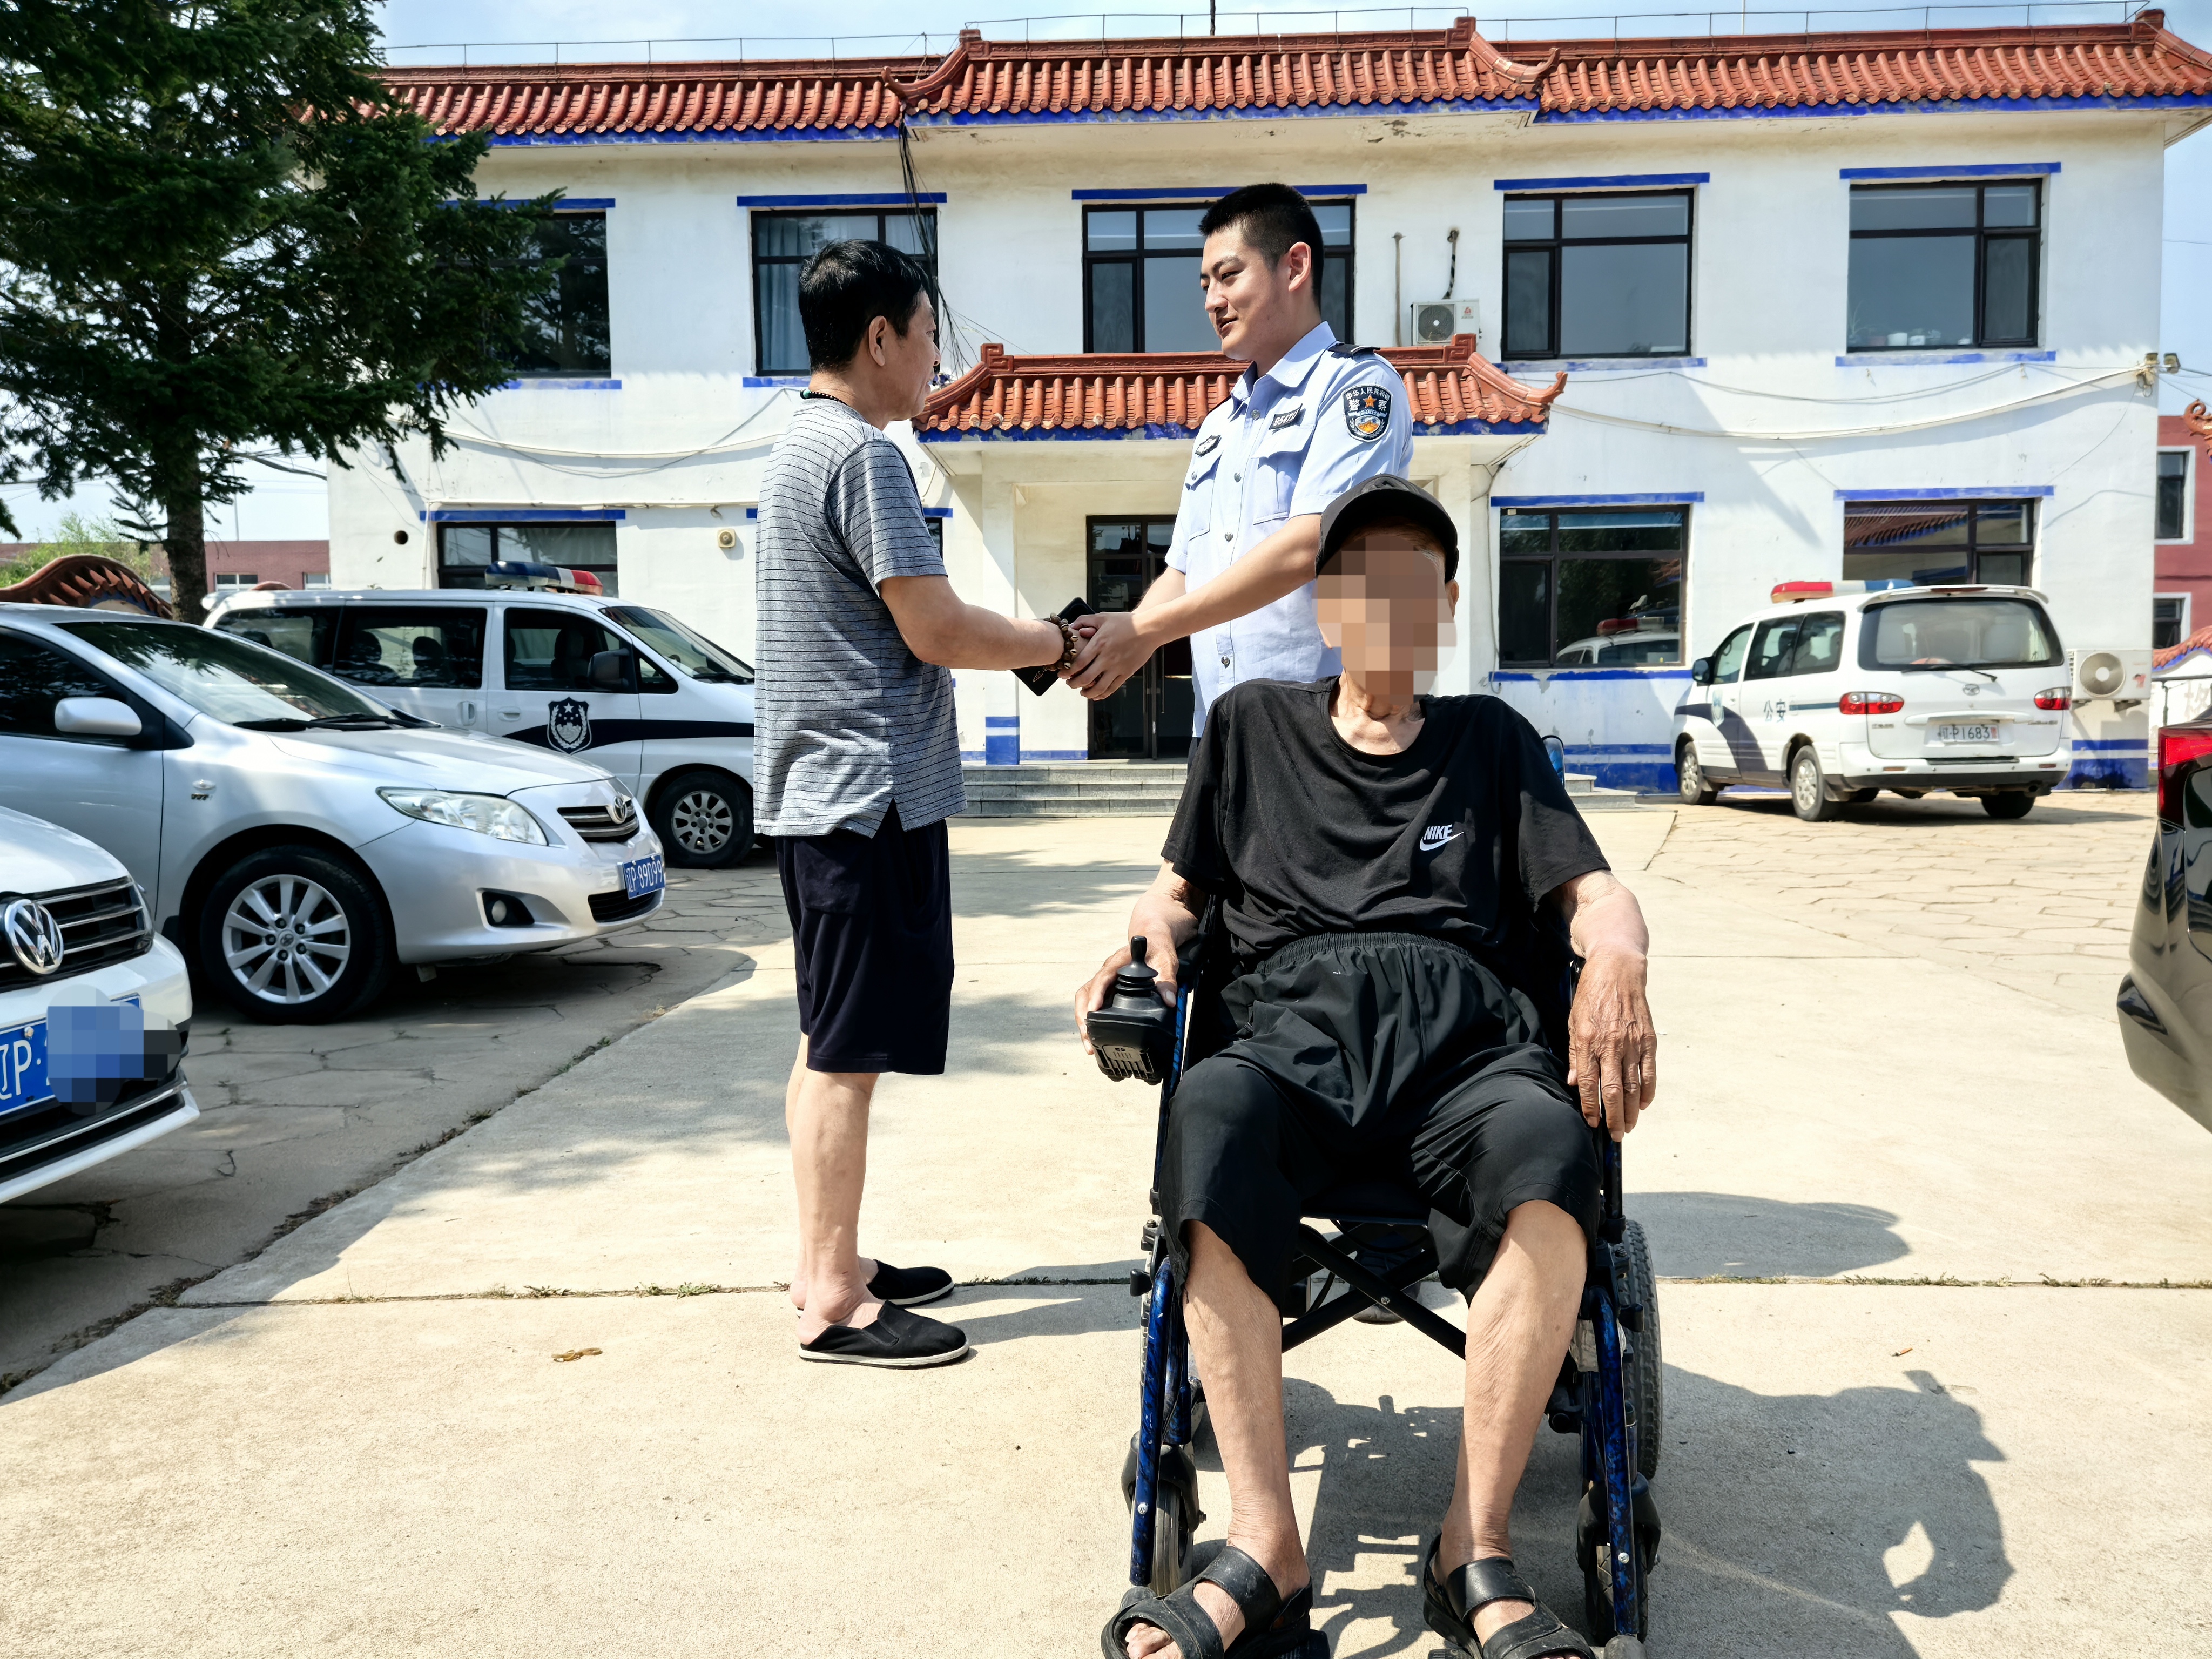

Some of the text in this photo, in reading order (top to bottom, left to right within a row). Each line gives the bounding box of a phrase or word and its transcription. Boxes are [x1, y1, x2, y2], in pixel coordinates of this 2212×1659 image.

[1345, 387, 1390, 401] 中华人民共和国
[1763, 698, 1786, 723] 公安
[1424, 824, 1453, 840] NIKE
